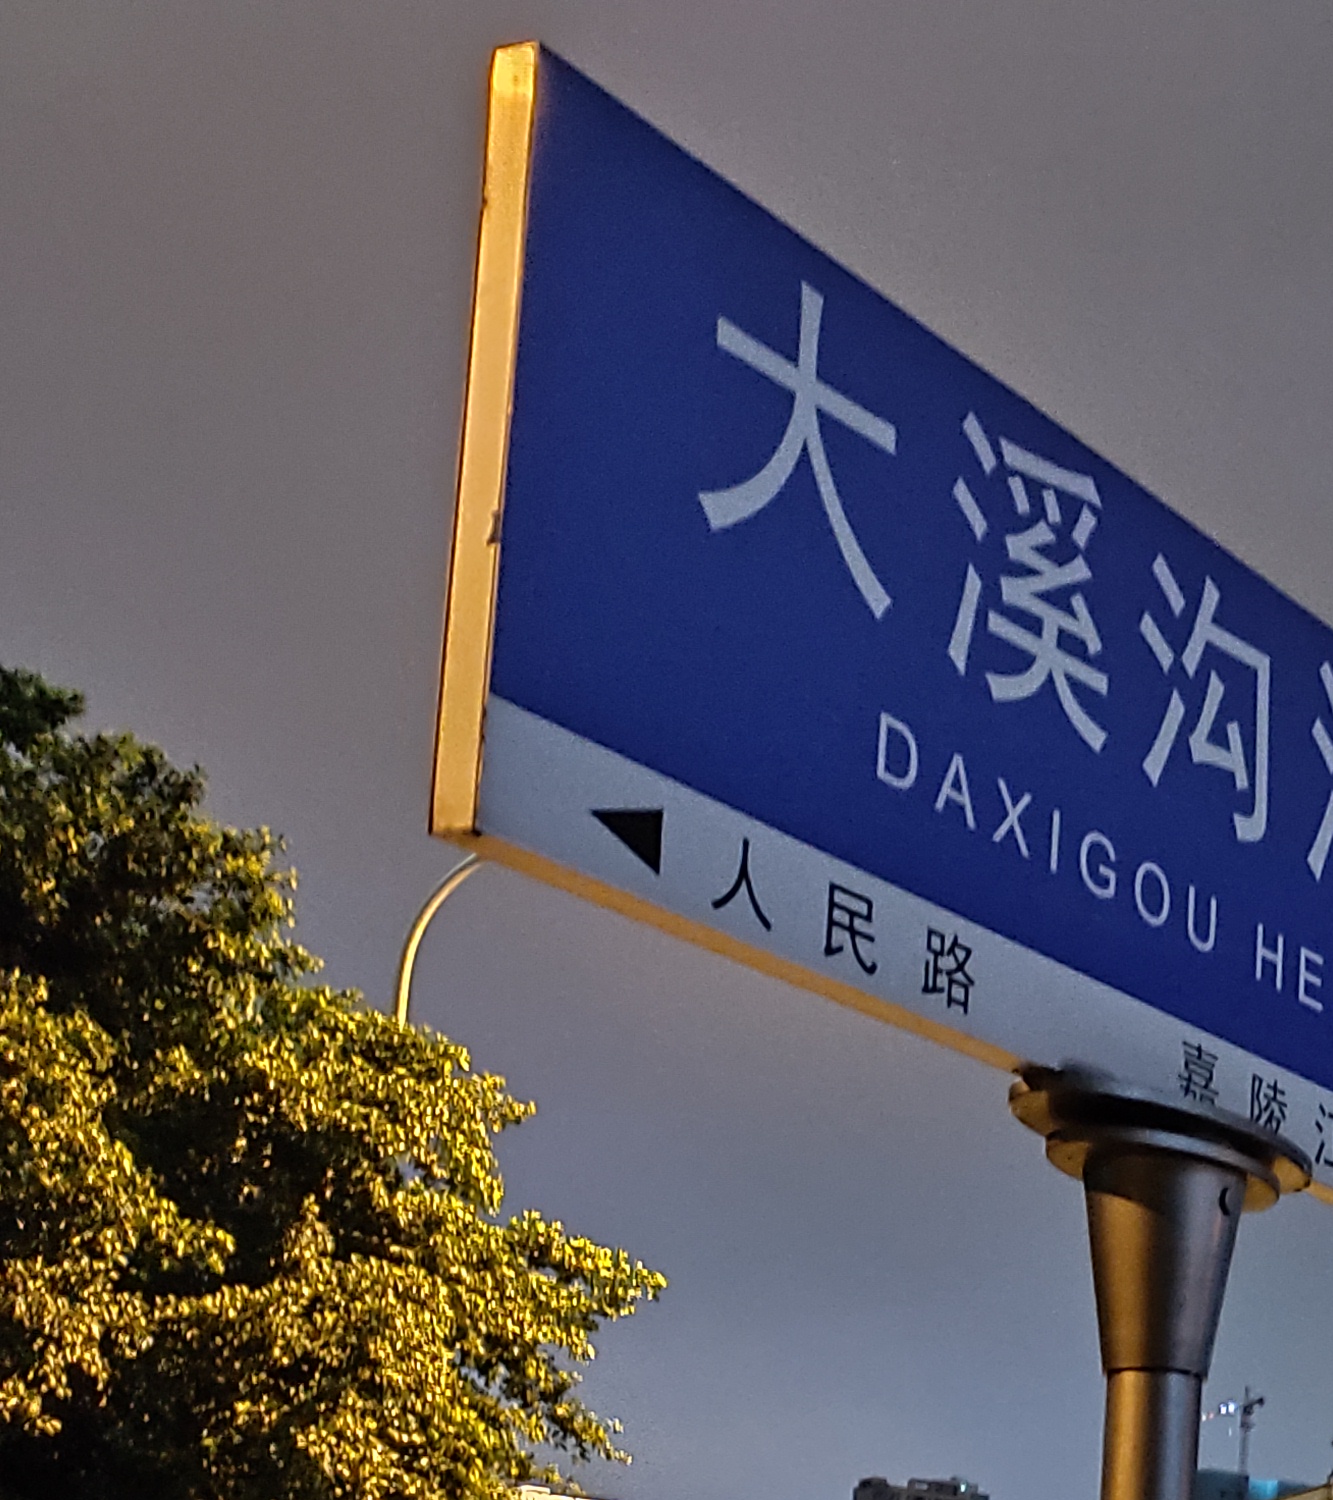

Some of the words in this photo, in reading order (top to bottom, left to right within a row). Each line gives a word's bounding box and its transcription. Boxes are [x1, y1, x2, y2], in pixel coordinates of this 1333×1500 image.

[711, 836, 975, 1015] 人民路
[875, 711, 1218, 952] DAXIGOU
